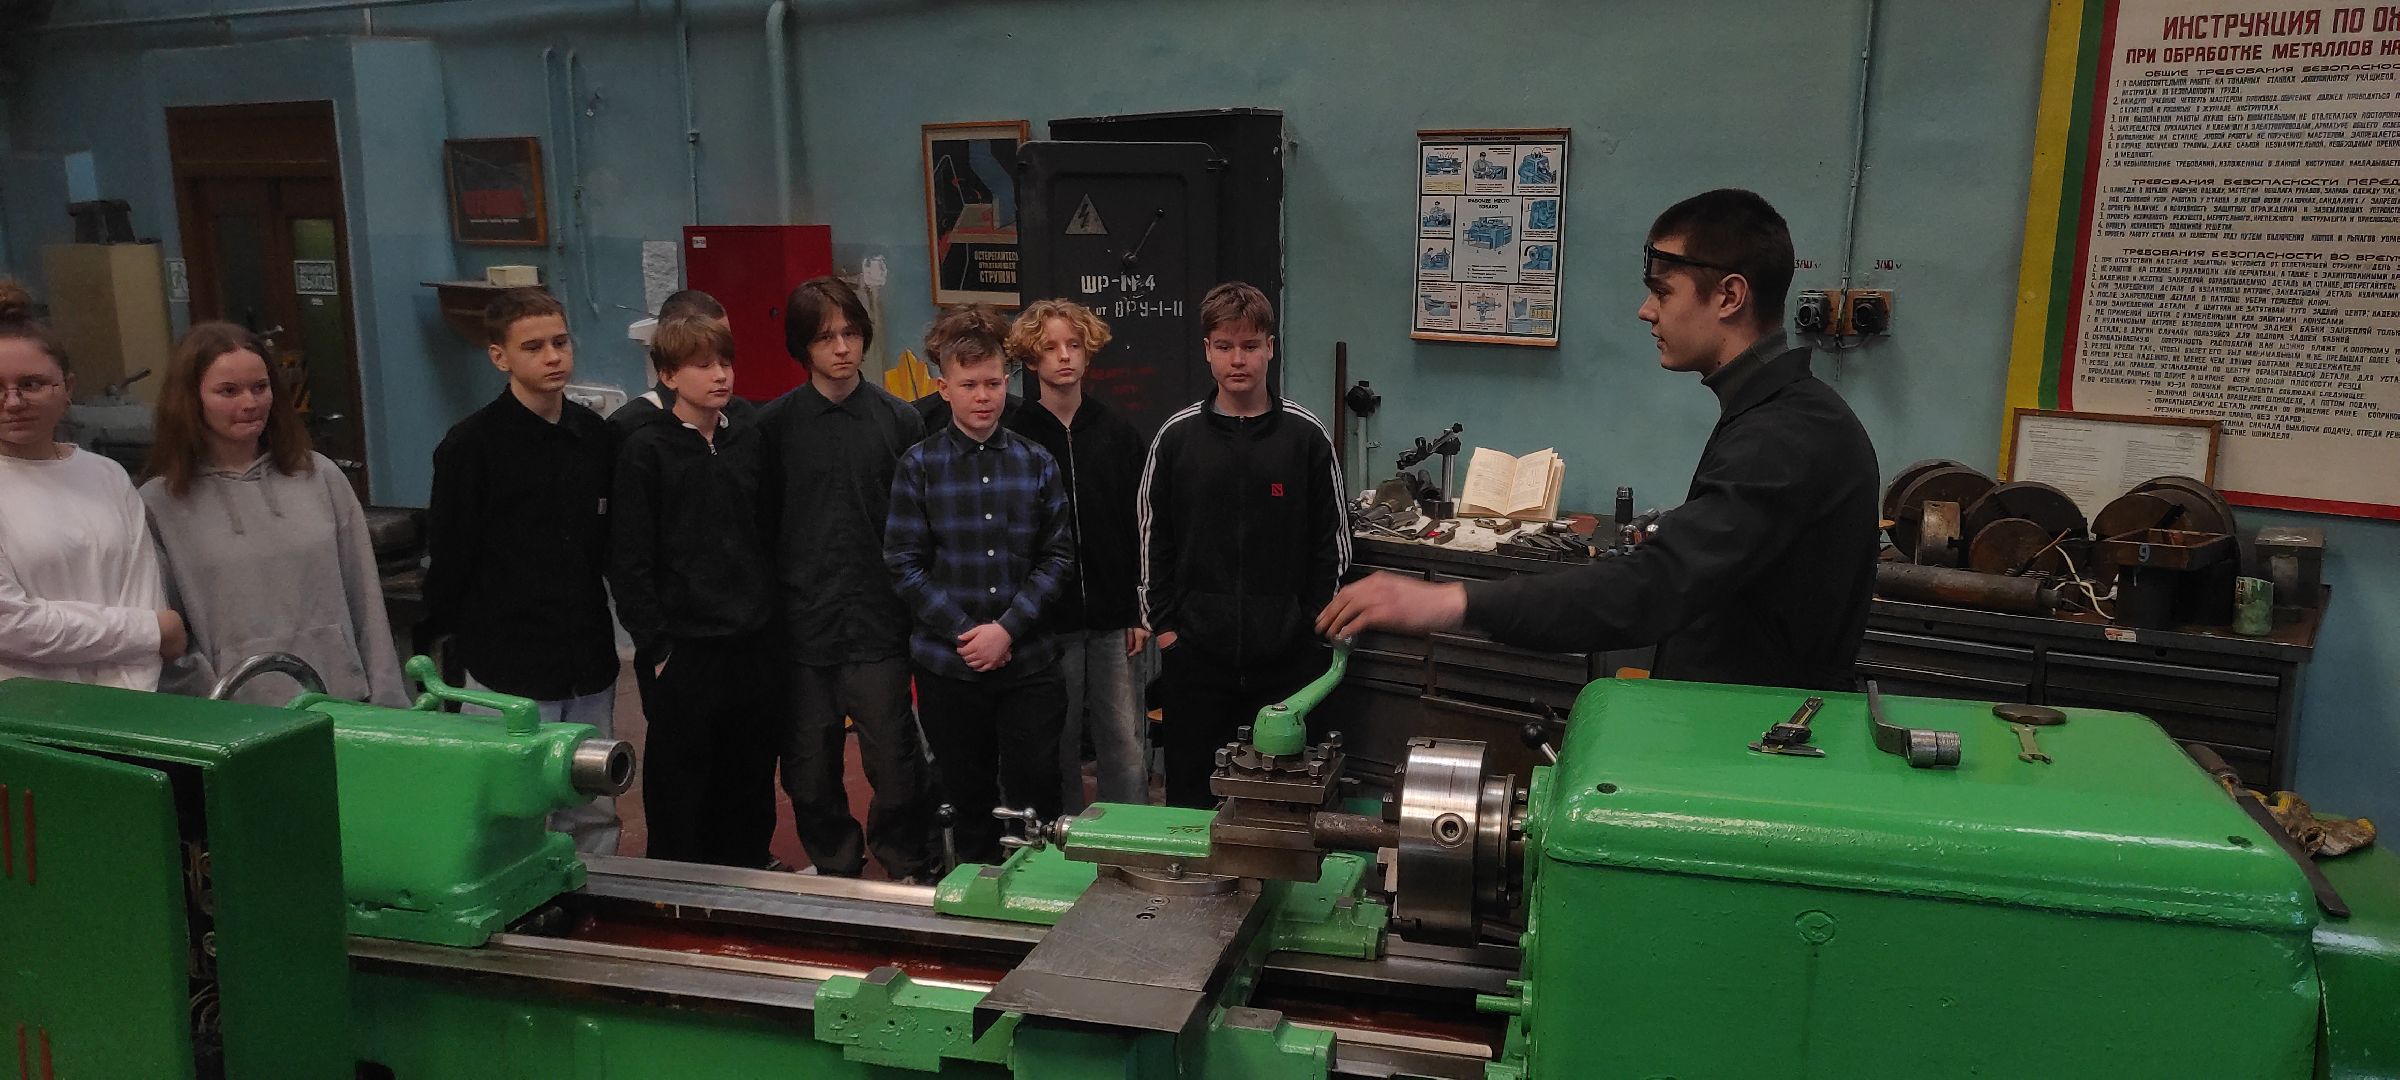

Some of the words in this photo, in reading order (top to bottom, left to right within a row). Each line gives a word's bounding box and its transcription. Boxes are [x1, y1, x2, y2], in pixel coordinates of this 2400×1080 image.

[2163, 10, 2321, 40] ИНСТРУКЦИЯ
[2332, 8, 2365, 33] ПО
[2126, 48, 2156, 64] ПРИ
[2164, 45, 2262, 63] ОБРАБОТКЕ
[2272, 40, 2373, 59] МЕТАЛЛОВ
[2197, 66, 2293, 75] ТРЕБОВАНИЯ
[2224, 178, 2338, 186] БЕЗОПАСНОСТИ
[2123, 249, 2205, 257] ТРЕБОВАНИЯ
[2212, 251, 2322, 260] БЕЗОПАСНОСТИ
[2138, 544, 2150, 562] 9
